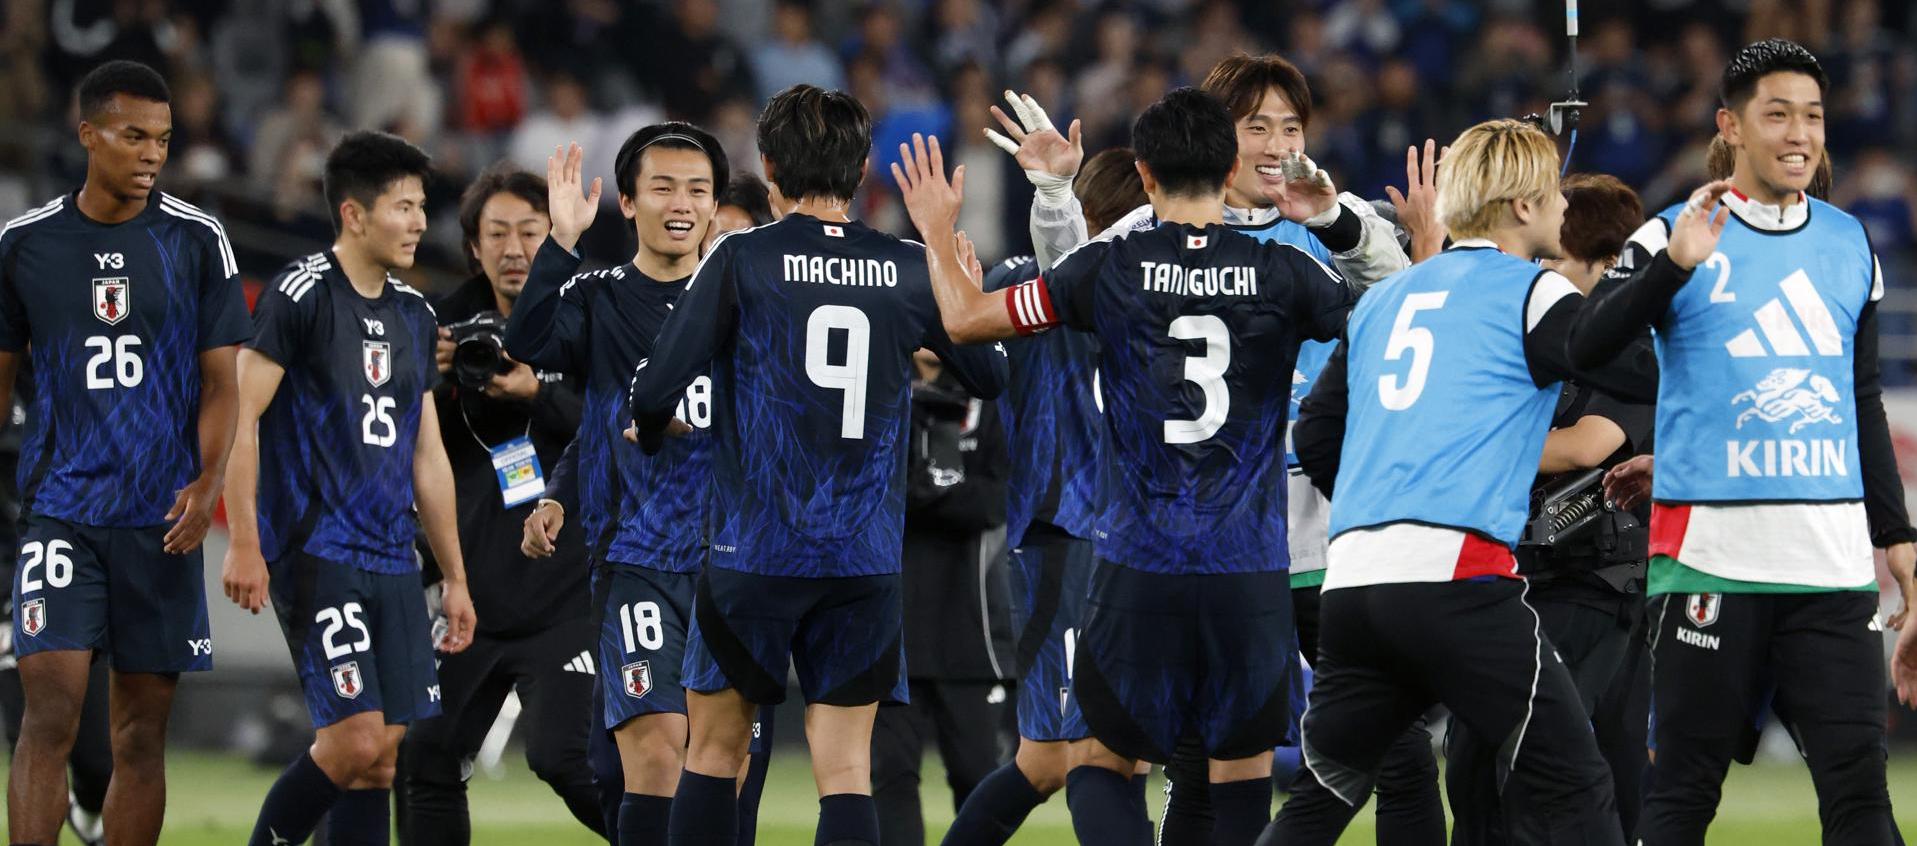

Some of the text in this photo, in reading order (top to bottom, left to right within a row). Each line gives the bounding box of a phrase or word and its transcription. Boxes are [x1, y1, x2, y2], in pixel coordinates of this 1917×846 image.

[94, 252, 125, 270] Y-3
[783, 254, 898, 288] MACHINO
[1140, 261, 1257, 297] TANIGUCHI
[1705, 250, 1736, 303] 2
[84, 334, 144, 390] 26
[805, 304, 871, 440] 9
[1378, 290, 1449, 411] 5
[675, 375, 712, 429] 8
[1163, 314, 1231, 444] 3
[361, 393, 397, 448] 25
[1727, 439, 1848, 477] KIRIN
[21, 538, 74, 595] 26
[187, 638, 212, 656] Y-3
[315, 602, 371, 660] 25
[619, 601, 664, 654] 18
[1676, 628, 1720, 650] KIRIN
